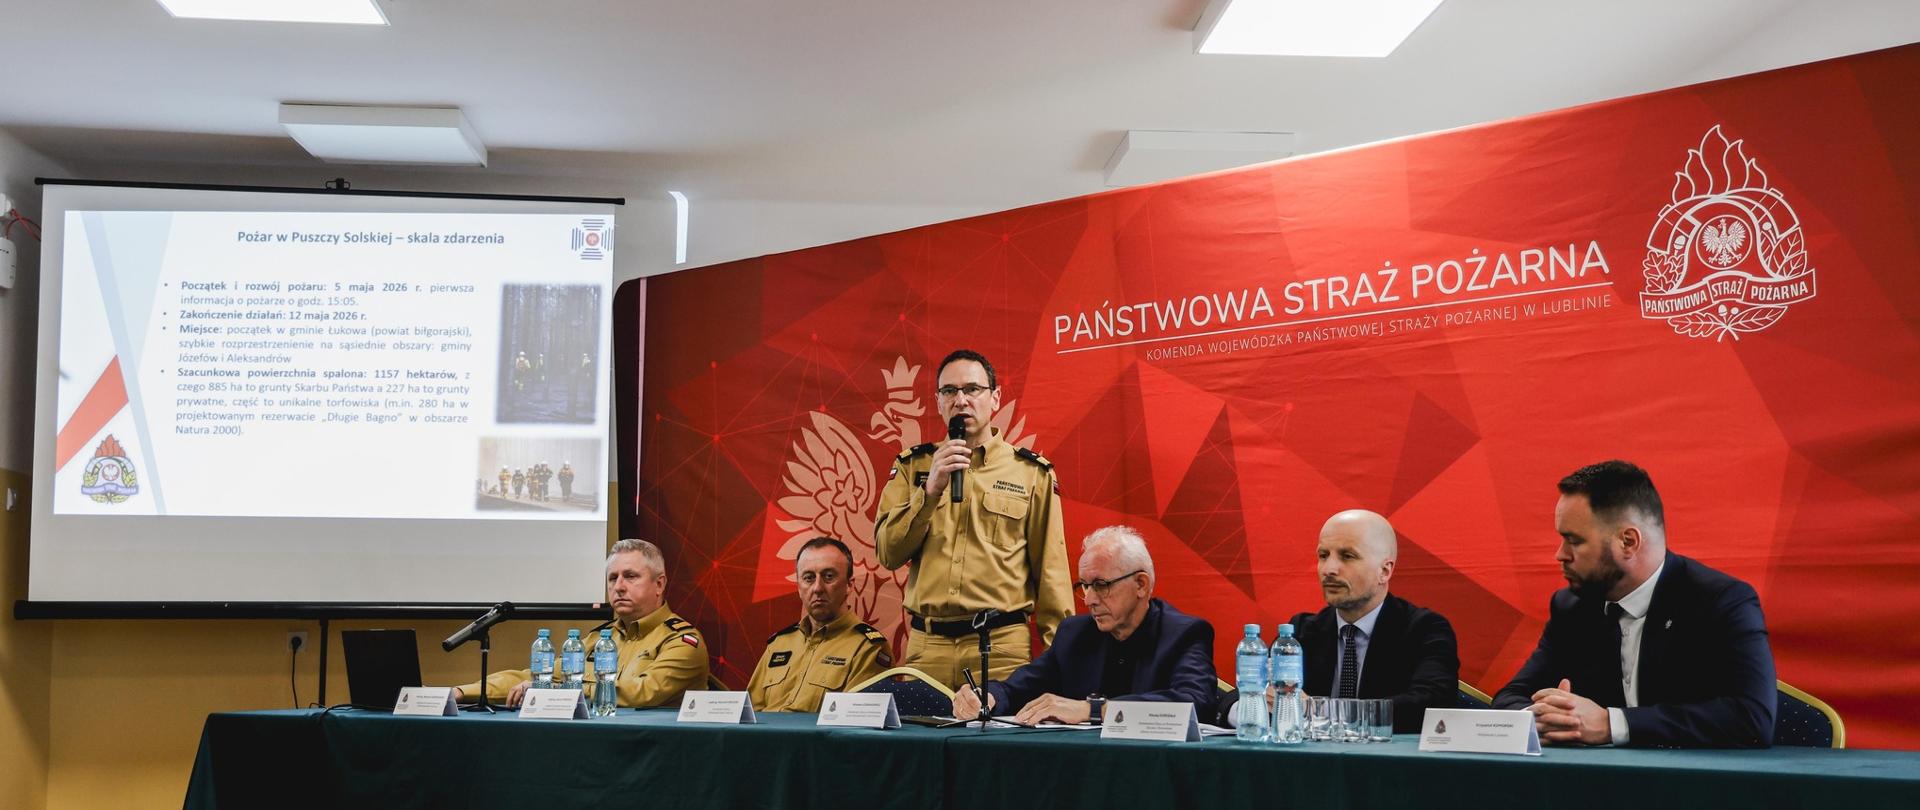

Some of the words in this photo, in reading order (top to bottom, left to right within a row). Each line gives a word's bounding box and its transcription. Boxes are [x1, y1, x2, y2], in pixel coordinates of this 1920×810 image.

[238, 231, 273, 242] Pożar
[276, 234, 288, 242] w
[292, 232, 340, 245] Puszczy
[344, 232, 392, 245] Solskiej
[408, 232, 439, 243] skala
[444, 232, 504, 244] zdarzenia
[181, 281, 227, 292] Początek
[245, 281, 280, 292] rozwój
[288, 283, 326, 292] pożaru:
[335, 283, 341, 291] 5
[349, 283, 374, 293] maja
[382, 283, 407, 291] 2026
[430, 283, 474, 294] pierwsza
[1055, 287, 1274, 344] PAŃSTWOWA
[1283, 261, 1400, 315] STRAŻ
[1411, 240, 1610, 298] POŻARNA
[181, 295, 234, 306] informacja
[247, 296, 285, 307] pożarze
[298, 295, 324, 307] godz.
[328, 296, 359, 306] 15:05.
[1645, 290, 1708, 313] PAŃSTWOWA
[1711, 278, 1743, 297] STRAŻ
[1751, 281, 1808, 301] POŻARNA
[180, 310, 243, 319] Zakończenie
[246, 310, 285, 319] działań:
[289, 311, 301, 320] 12
[304, 311, 329, 322] maja
[333, 312, 358, 320] 2026
[180, 324, 222, 335] Miejsce:
[227, 325, 272, 336] początek
[289, 326, 324, 336] gminie
[327, 326, 366, 335] Łukowa
[371, 326, 409, 337] (powiat
[1146, 344, 1203, 361] KOMENDA
[1208, 334, 1292, 354] WOJEWÓDZKA
[1297, 322, 1384, 342] PAŃSTWOWEJ
[1390, 314, 1439, 332] STRAŻY
[1445, 306, 1517, 325] POŻARNEJ
[1523, 304, 1536, 317] W
[1543, 294, 1611, 315] LUBLINIE
[179, 338, 215, 350] szybkie
[222, 339, 314, 350] rozprzestrzenienie
[339, 340, 386, 351] sąsiednie
[393, 340, 434, 352] obszary:
[440, 342, 471, 352] gminy
[178, 352, 218, 363] Józefów
[227, 352, 292, 363] Aleksandrów
[178, 368, 240, 377] Szacunkowa
[248, 368, 316, 379] powierzchnia
[323, 368, 367, 379] spalona:
[375, 370, 399, 378] 1157
[407, 369, 457, 380] hektarów,
[177, 384, 206, 393] czego
[208, 382, 227, 391] 885
[230, 382, 242, 391] ha
[246, 384, 256, 392] to
[258, 384, 292, 393] grunty
[295, 383, 329, 392] Skarbu
[332, 383, 374, 392] Państwa
[386, 384, 405, 393] 227
[408, 384, 420, 393] ha
[423, 385, 434, 393] to
[436, 384, 469, 395] grunty
[177, 398, 227, 409] prywatne,
[232, 397, 259, 408] część
[264, 398, 274, 407] to
[279, 397, 321, 407] unikalne
[327, 397, 379, 407] torfowiska
[385, 398, 413, 410] (m.in.
[419, 399, 438, 408] 280
[443, 399, 456, 408] ha
[176, 411, 255, 423] projektowanym
[261, 412, 316, 421] rezerwacie
[424, 413, 468, 423] obszarze
[176, 425, 210, 434] Natura
